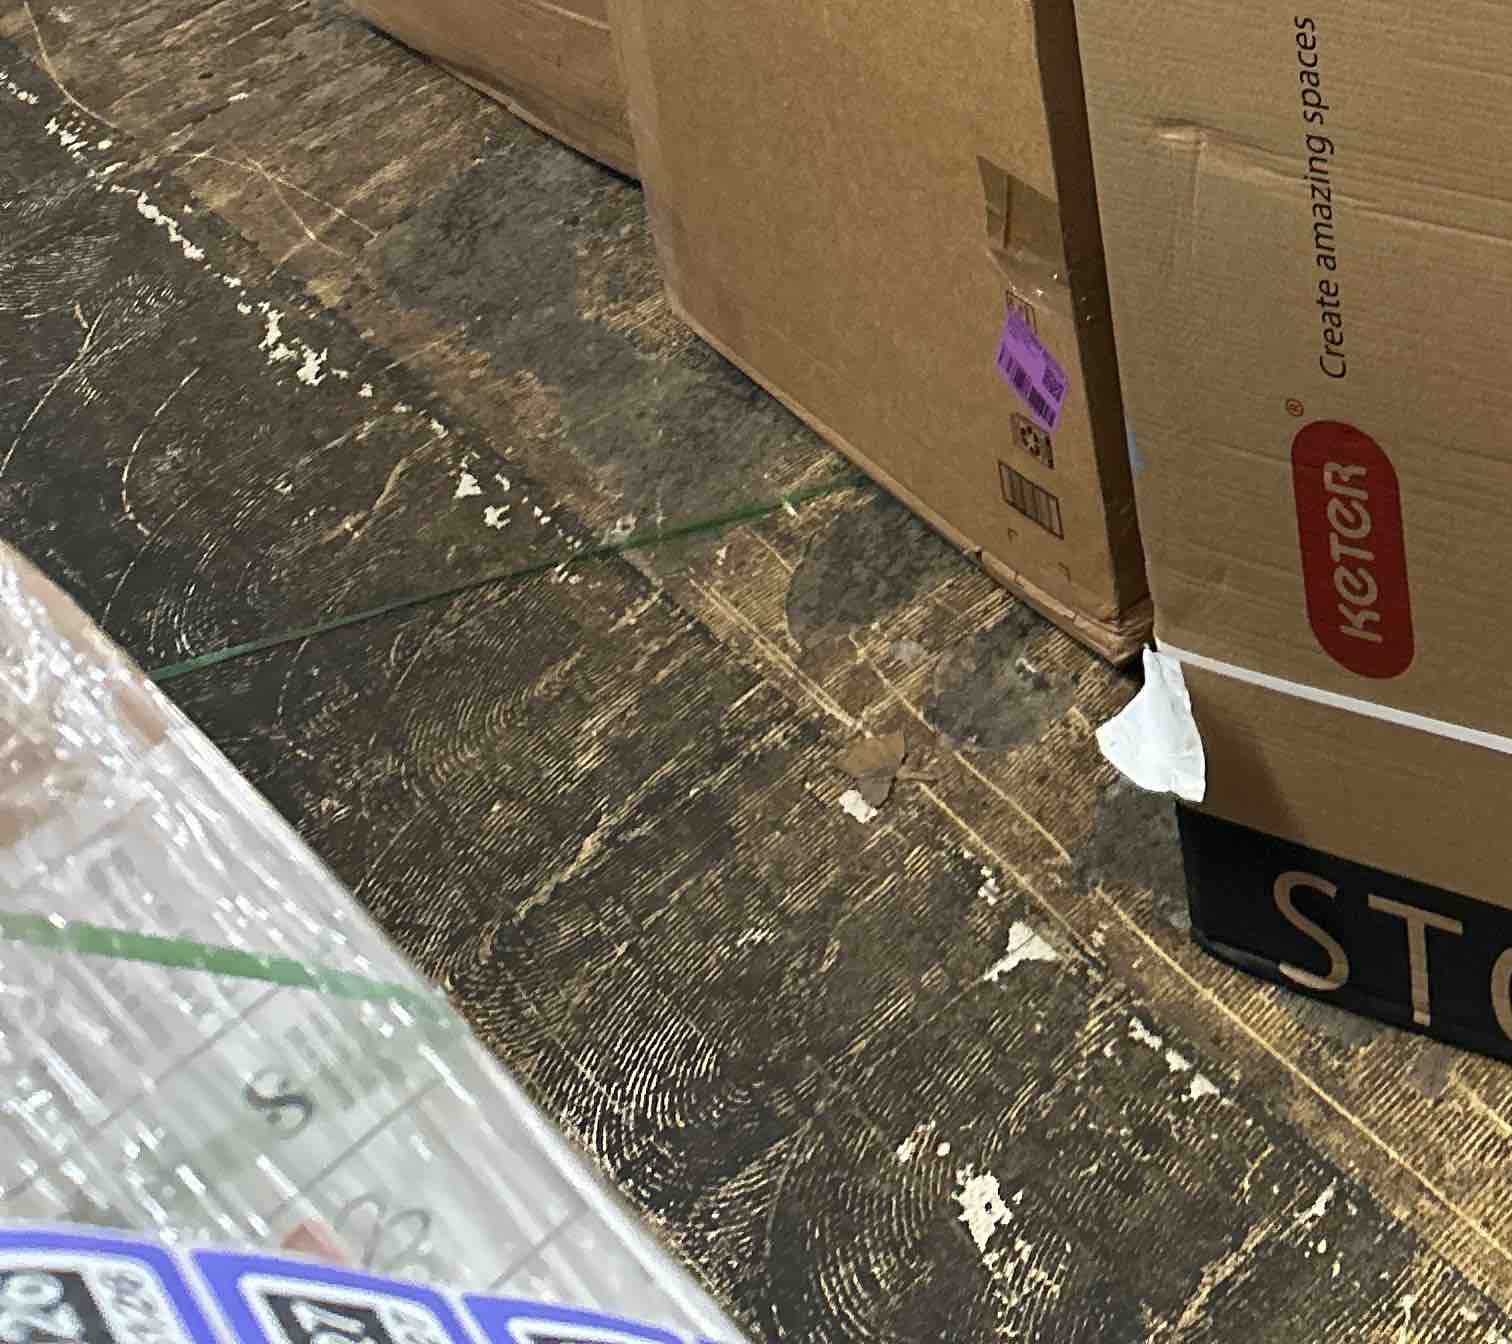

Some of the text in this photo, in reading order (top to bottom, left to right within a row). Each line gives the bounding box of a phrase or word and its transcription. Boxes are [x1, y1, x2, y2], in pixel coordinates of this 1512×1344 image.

[1294, 15, 1329, 126] spaces
[1304, 134, 1337, 272] amazing
[1315, 278, 1346, 379] Create
